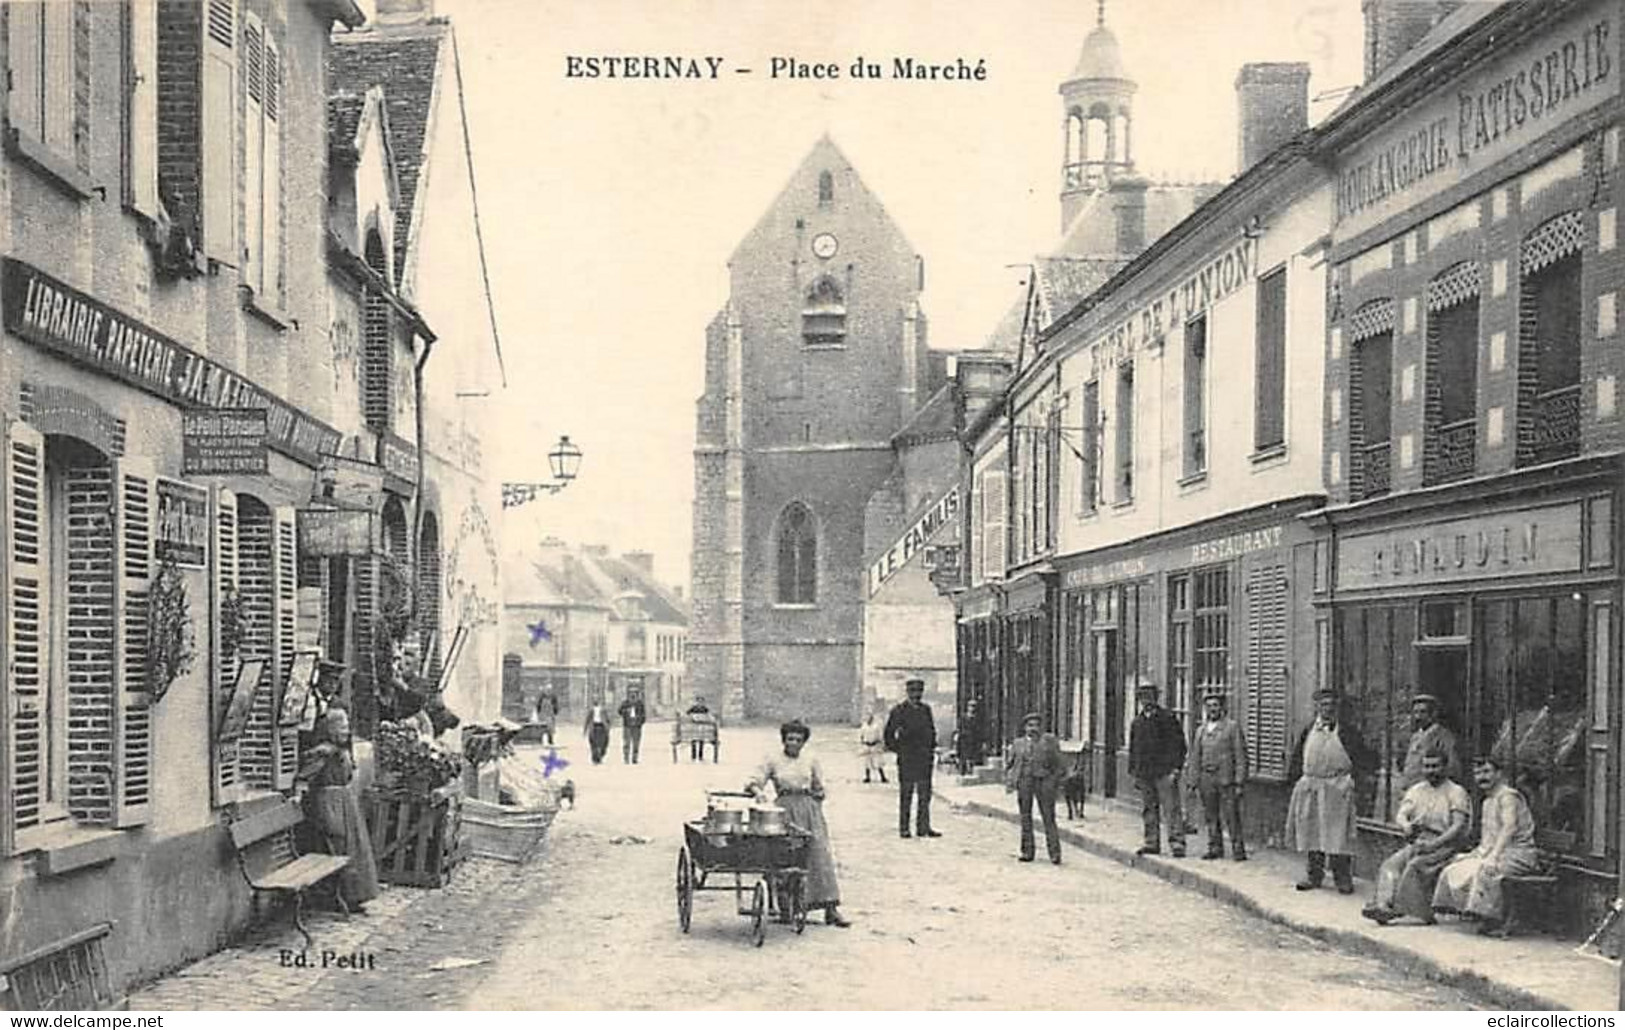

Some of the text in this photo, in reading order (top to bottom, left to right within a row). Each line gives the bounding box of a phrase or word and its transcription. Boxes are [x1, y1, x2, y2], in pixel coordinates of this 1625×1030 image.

[1457, 20, 1612, 158] PATISSERIE
[106, 319, 175, 385] PAPETERIE
[878, 555, 896, 583] LE
[1191, 526, 1284, 564] RESTAURANT
[1372, 521, 1540, 578] RENAUDIN
